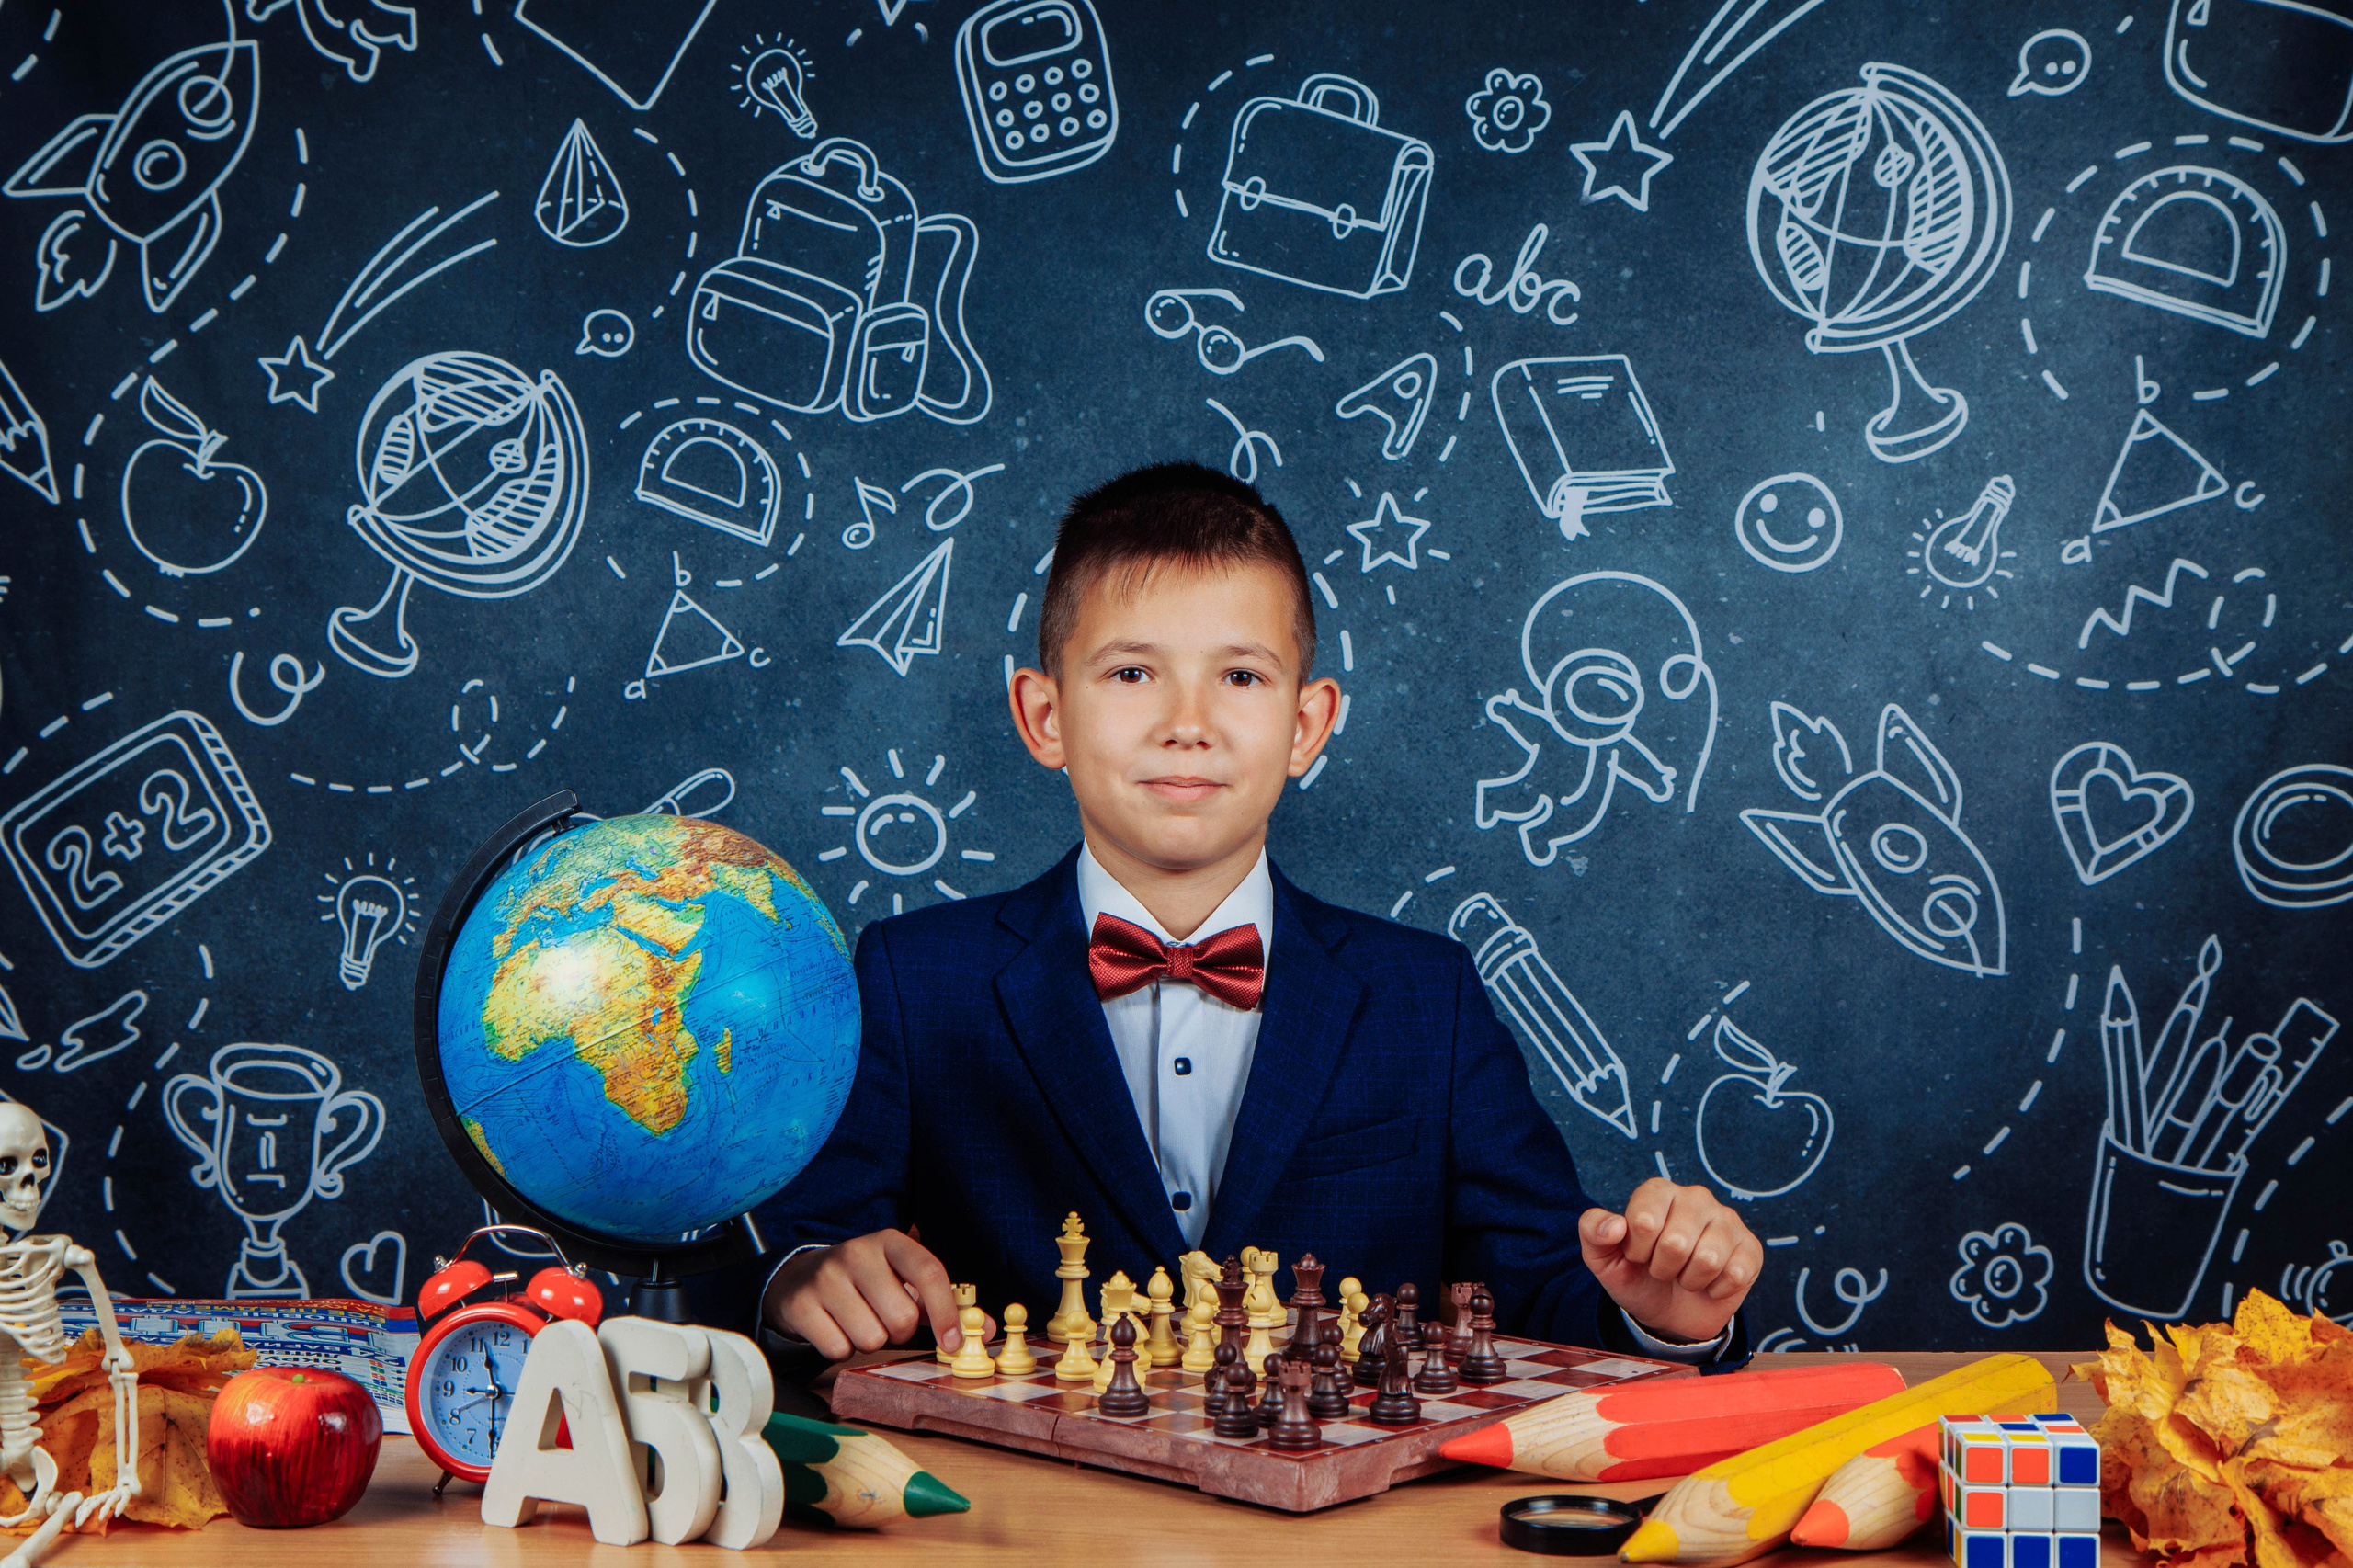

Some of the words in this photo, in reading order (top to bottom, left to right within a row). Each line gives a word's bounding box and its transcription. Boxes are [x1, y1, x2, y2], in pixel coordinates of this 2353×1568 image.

[1453, 222, 1581, 325] abc
[2135, 354, 2161, 404] b
[2234, 480, 2266, 510] c
[2061, 534, 2092, 565] a
[673, 550, 692, 587] b
[749, 647, 771, 668] c
[624, 677, 647, 699] a
[327, 1309, 386, 1324] ВСЕ
[470, 1337, 484, 1354] 11
[494, 1331, 511, 1347] 12
[450, 1356, 468, 1373] 10
[443, 1381, 455, 1398] 9
[449, 1407, 461, 1426] 8
[466, 1428, 477, 1445] 7
